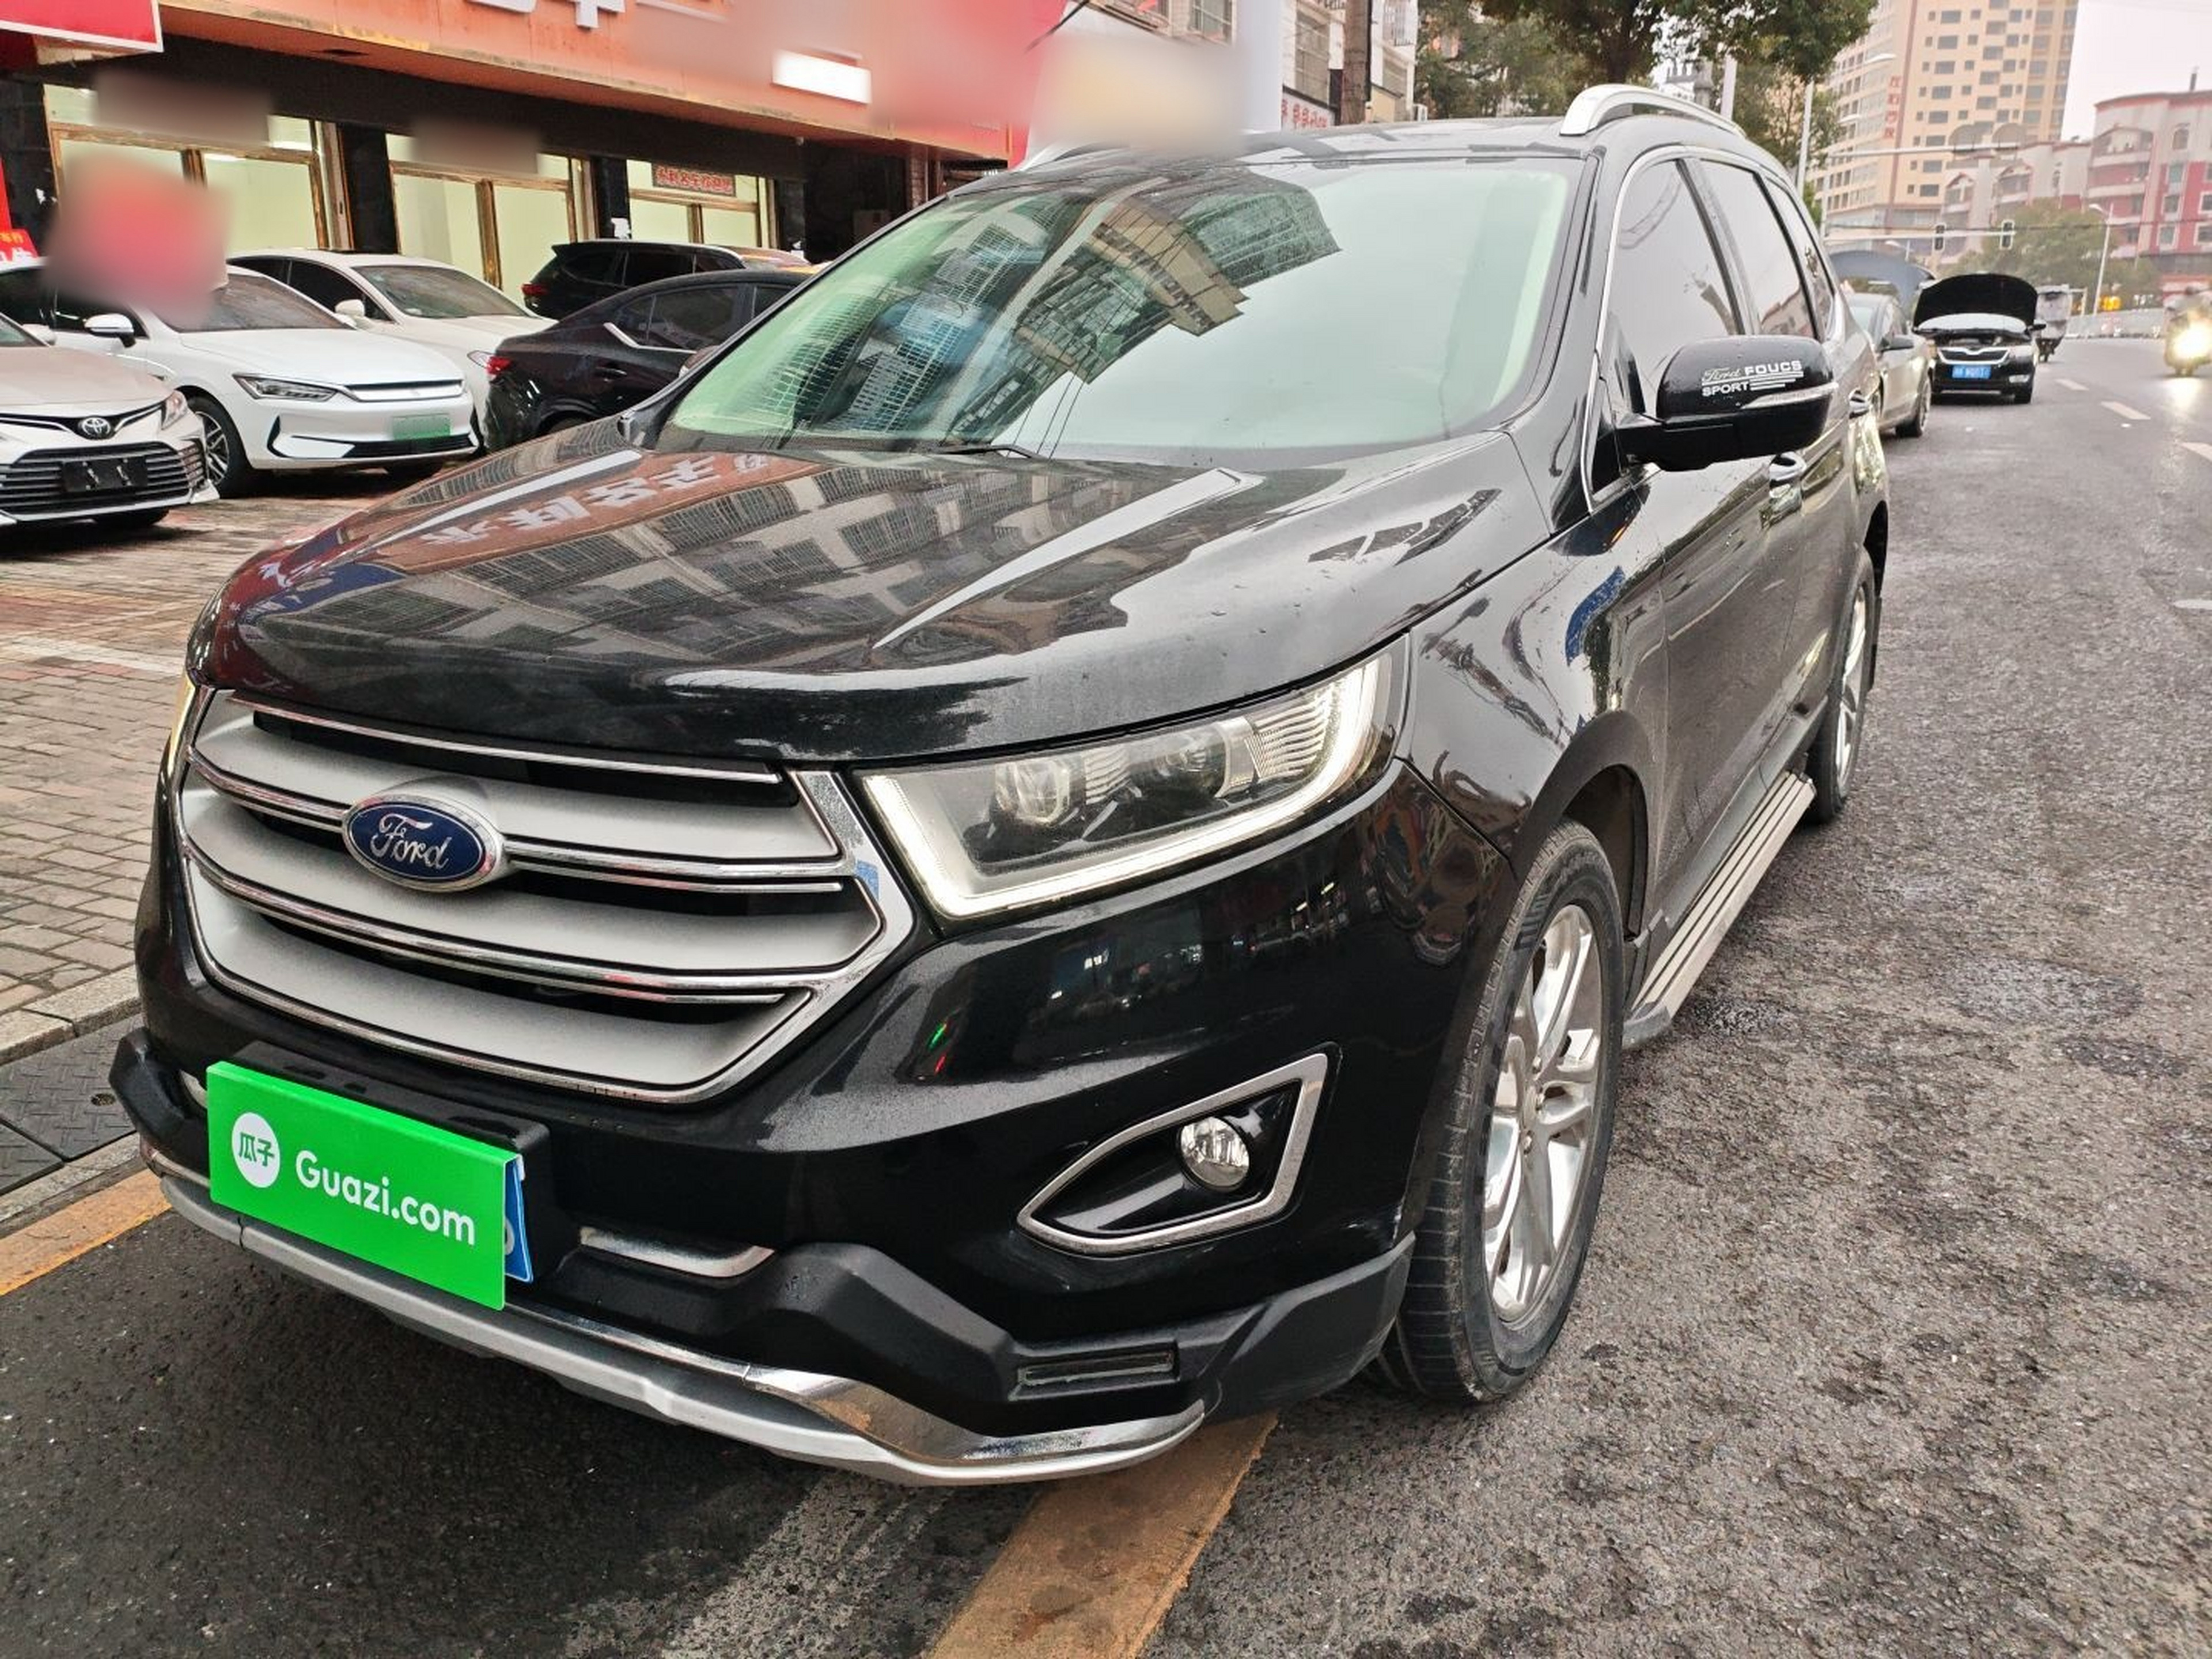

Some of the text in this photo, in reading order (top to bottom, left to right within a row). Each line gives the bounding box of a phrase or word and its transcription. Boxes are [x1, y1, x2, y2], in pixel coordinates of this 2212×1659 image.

[1702, 360, 1802, 381] Ford FOUCS
[1702, 381, 1748, 396] SPORT
[370, 813, 452, 869] Ford
[238, 1131, 275, 1168] 瓜子
[296, 1150, 475, 1246] Guazi.com
